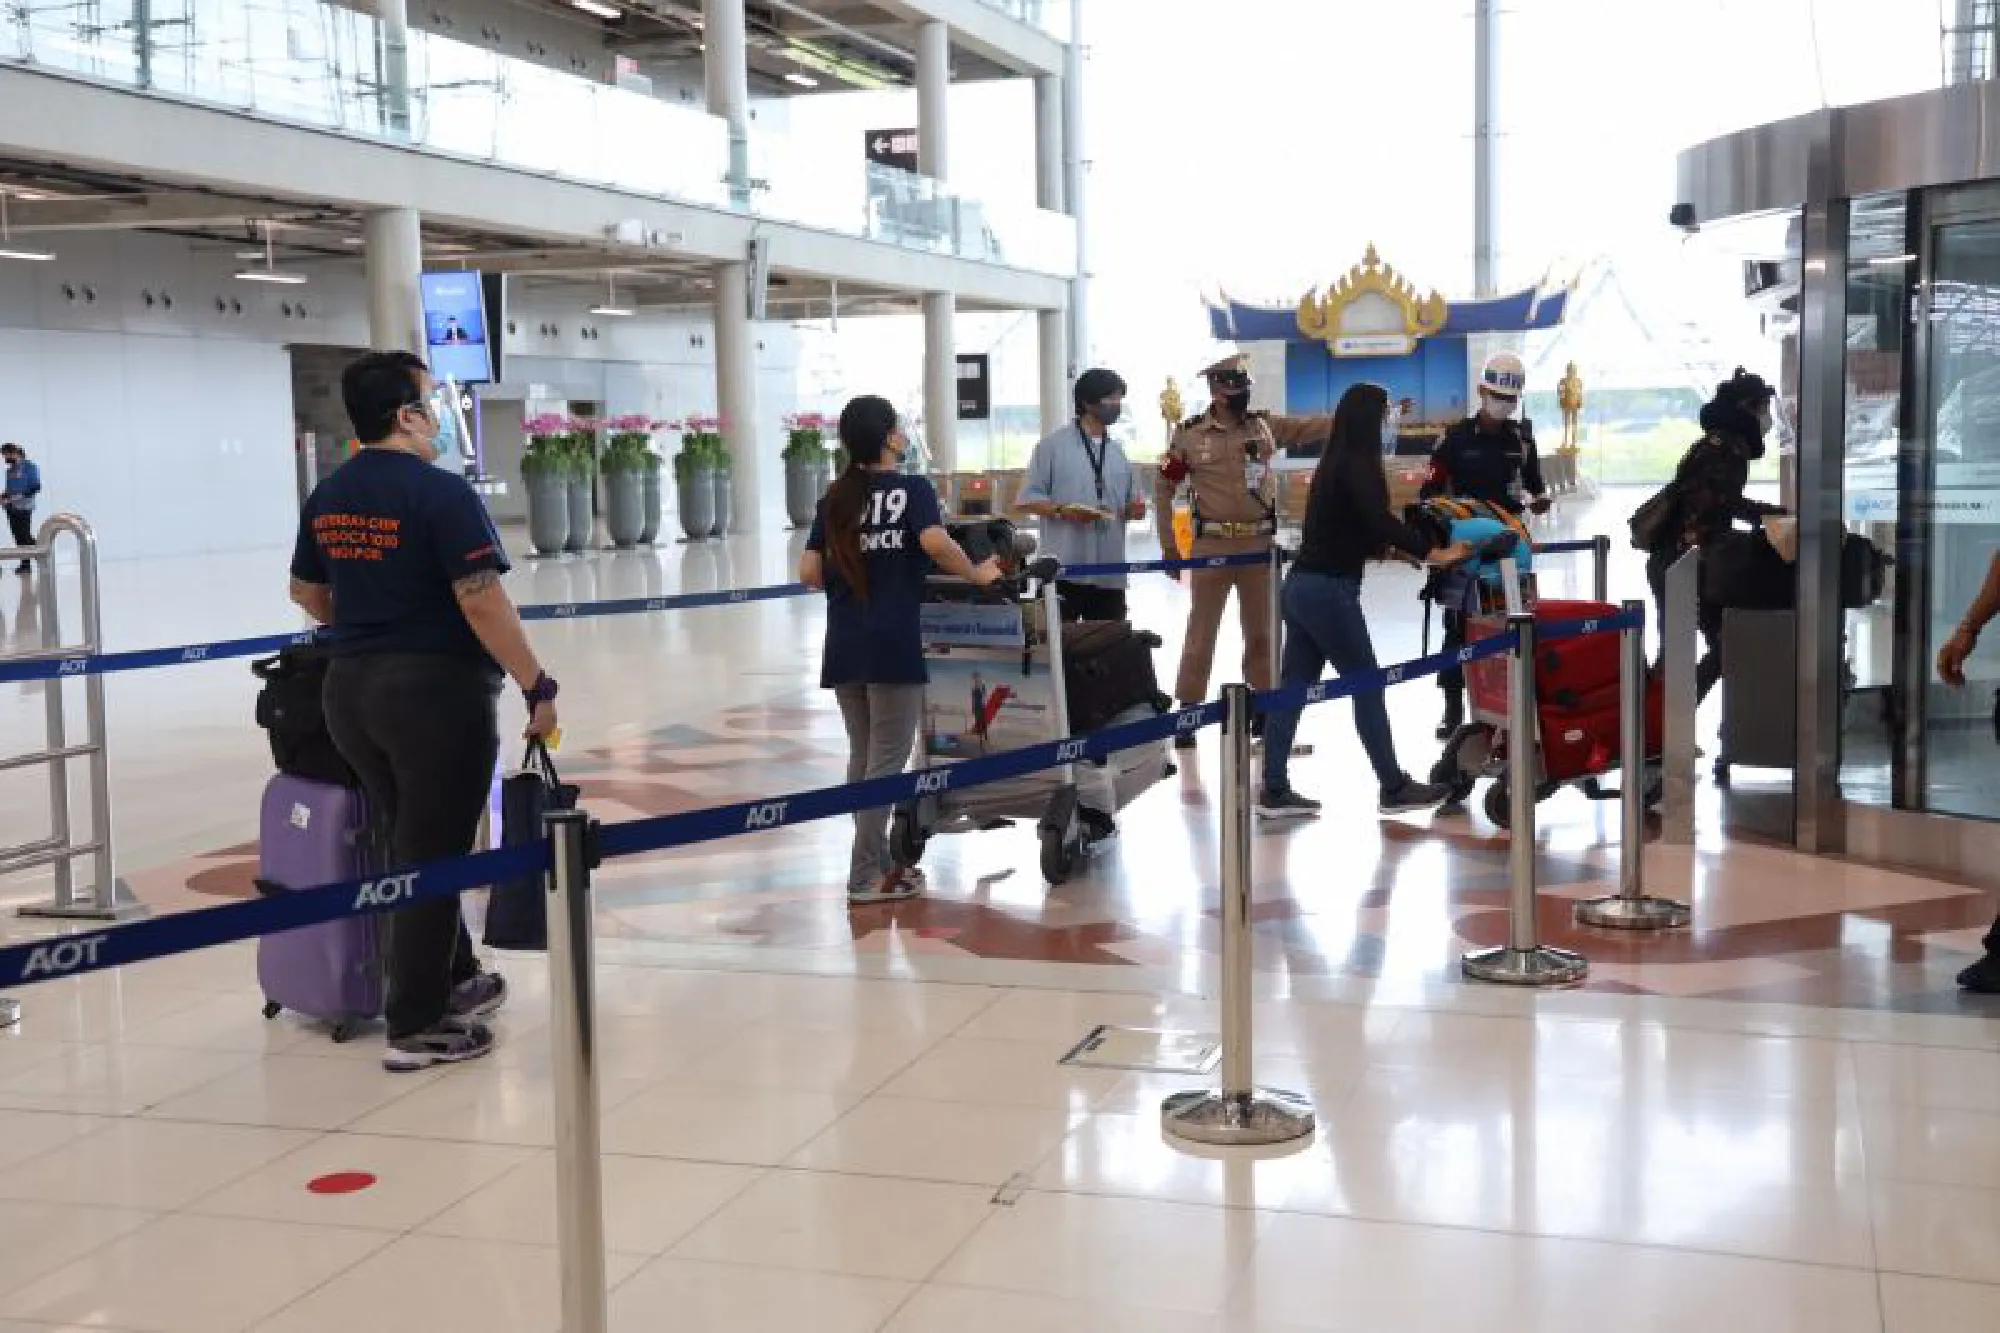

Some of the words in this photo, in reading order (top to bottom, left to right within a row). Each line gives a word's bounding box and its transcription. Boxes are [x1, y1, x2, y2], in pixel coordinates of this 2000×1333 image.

[57, 659, 86, 675] AOT
[1176, 709, 1205, 731] AOT
[1056, 739, 1088, 761] AOT
[915, 769, 952, 794] AOT
[745, 802, 788, 829] AOT
[352, 869, 421, 910] AOT
[21, 934, 108, 978] AOT
